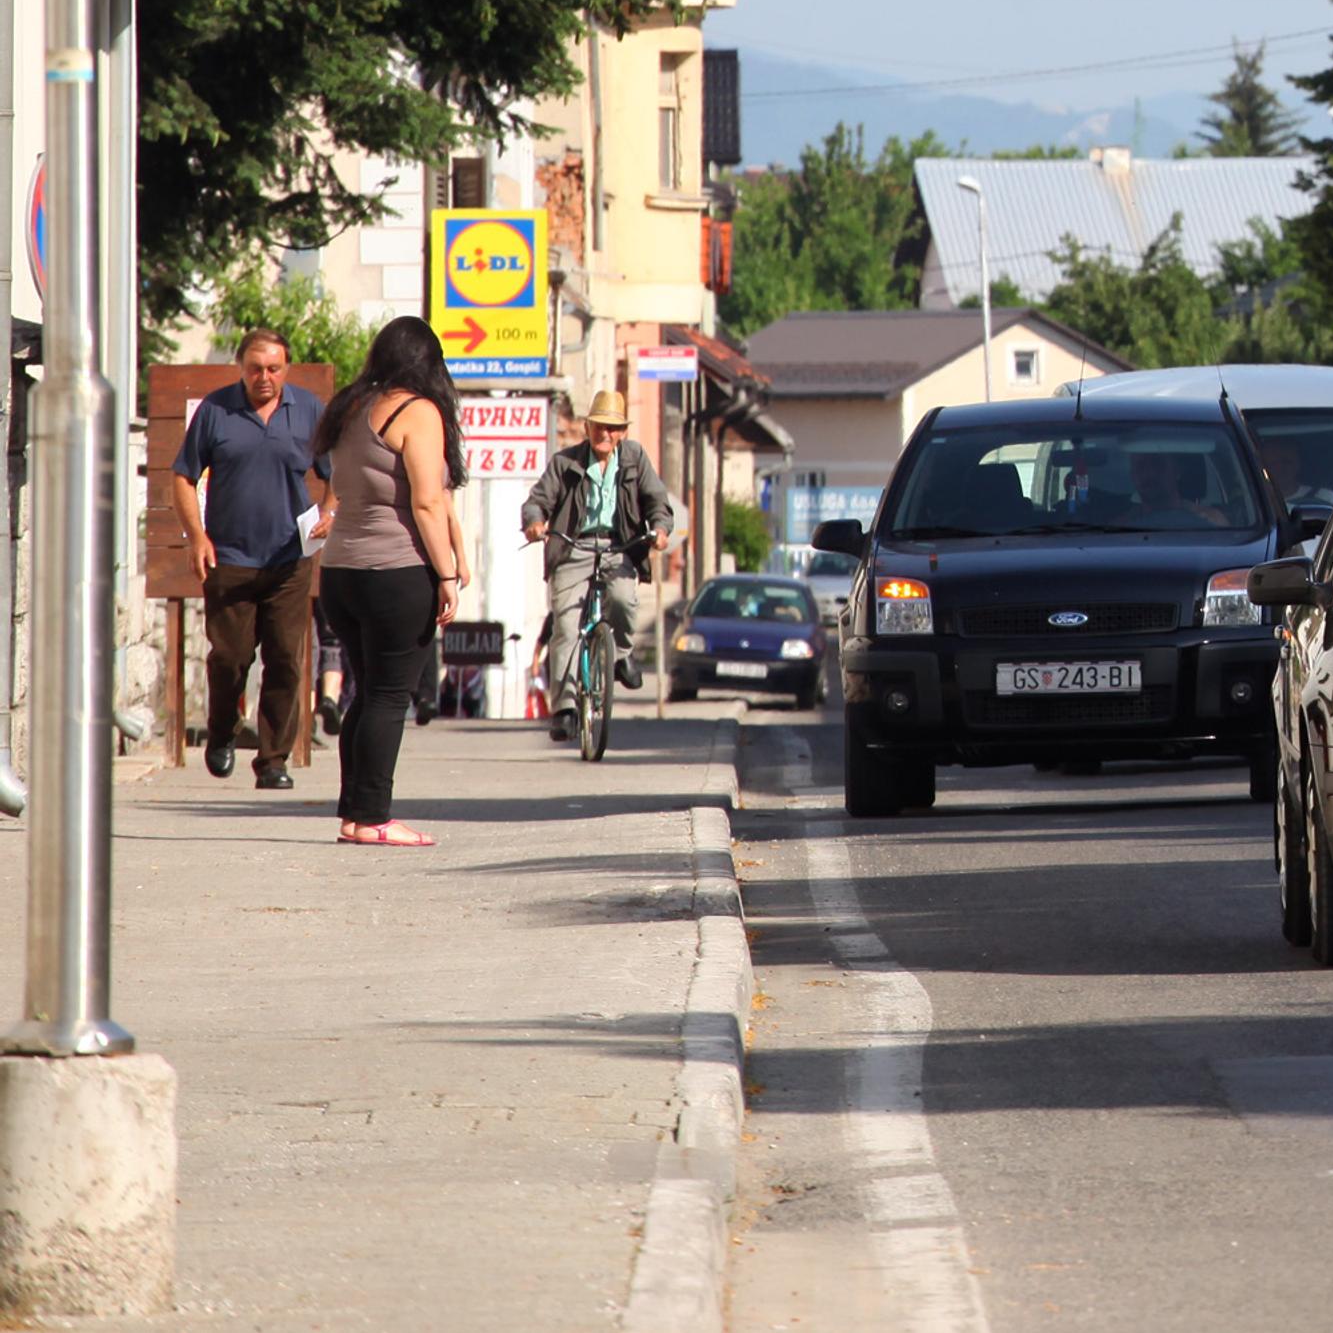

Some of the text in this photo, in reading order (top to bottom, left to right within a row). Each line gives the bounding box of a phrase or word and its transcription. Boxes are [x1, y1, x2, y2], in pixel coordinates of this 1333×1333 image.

[496, 328, 538, 341] 100 m
[460, 406, 541, 427] AVANA
[466, 449, 538, 471] IZZA
[445, 631, 501, 653] BILJAR
[1013, 666, 1133, 689] GS 243-BI
